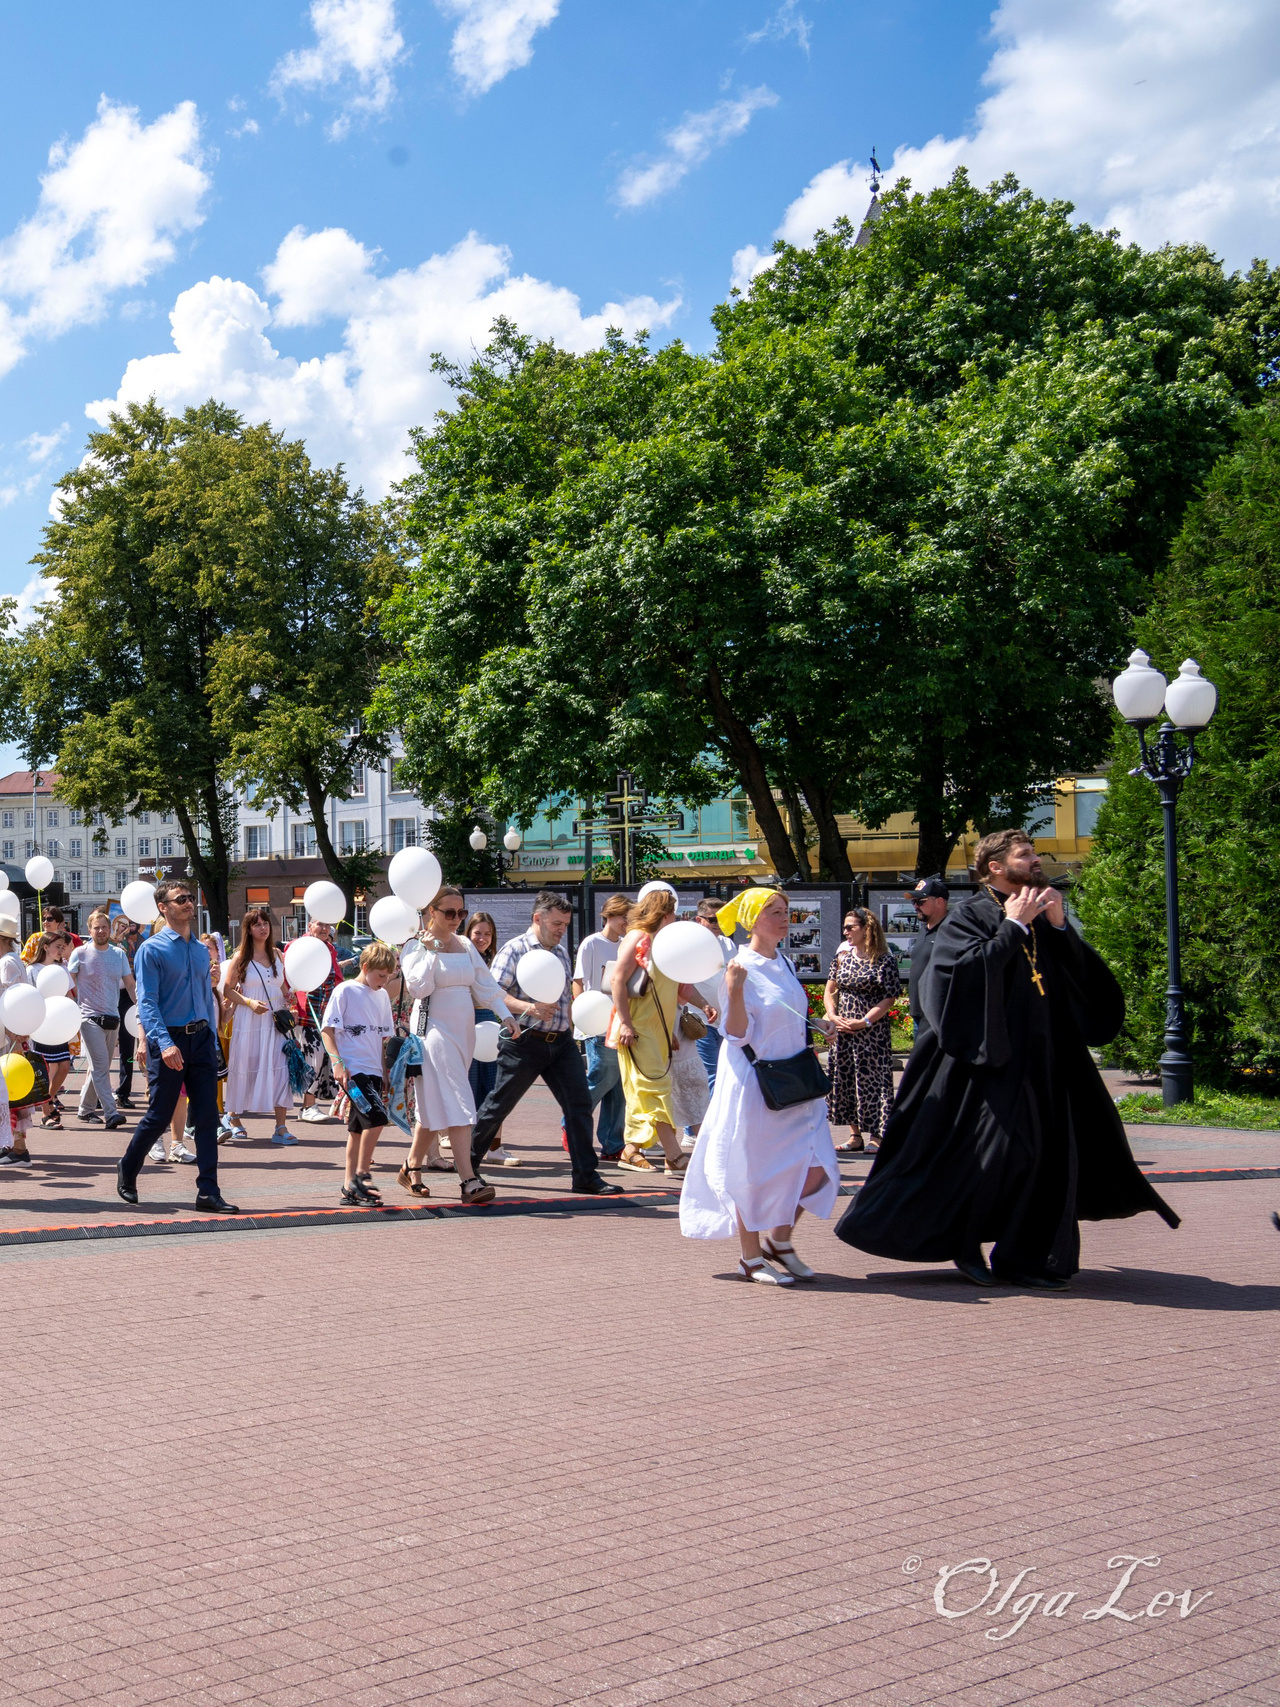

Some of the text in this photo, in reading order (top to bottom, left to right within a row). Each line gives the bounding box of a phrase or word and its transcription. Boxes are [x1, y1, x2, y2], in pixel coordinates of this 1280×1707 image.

[520, 854, 559, 867] Силуэт
[567, 849, 735, 864] МУСКА ЕНСКАЯ ОДЕЖДА
